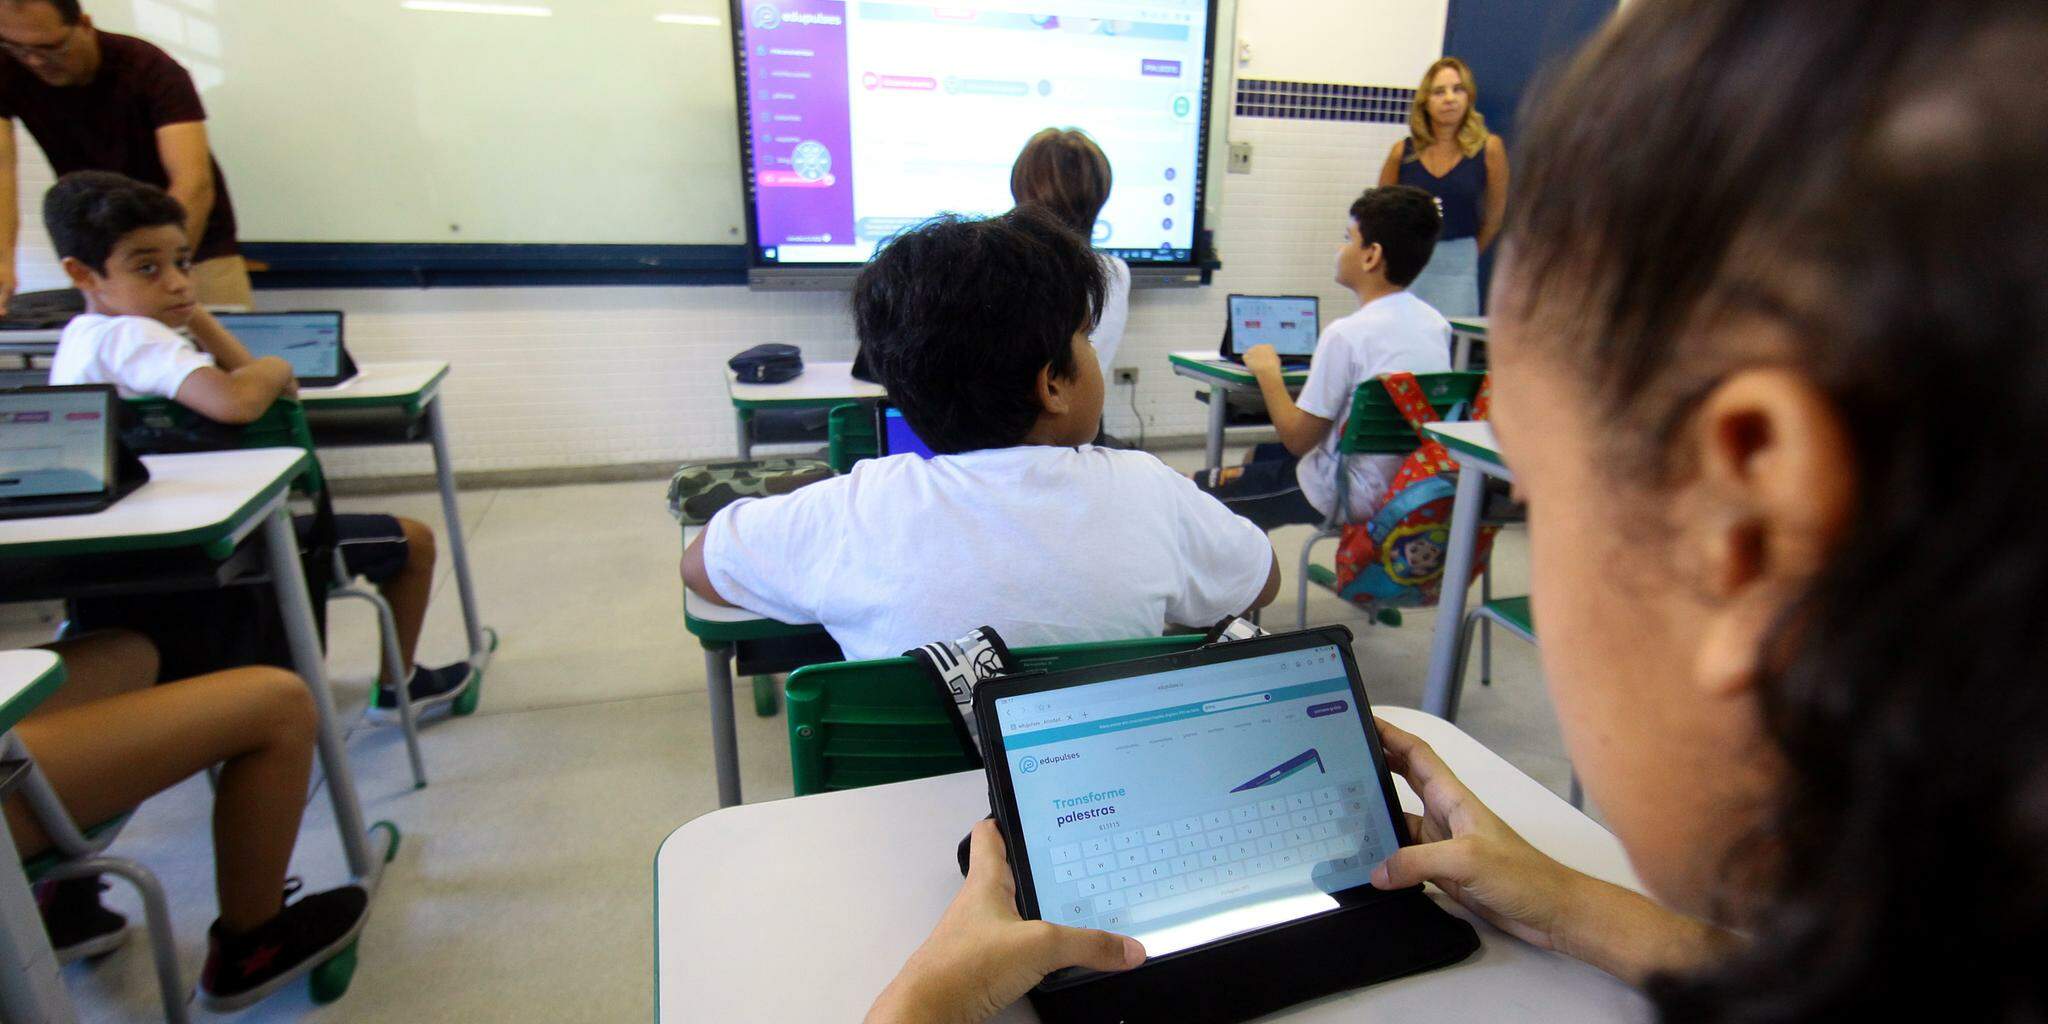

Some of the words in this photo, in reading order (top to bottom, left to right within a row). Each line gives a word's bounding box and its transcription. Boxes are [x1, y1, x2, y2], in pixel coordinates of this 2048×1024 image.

[1039, 751, 1080, 765] edupulses
[1053, 787, 1126, 809] Transforme
[1056, 805, 1116, 828] palestras
